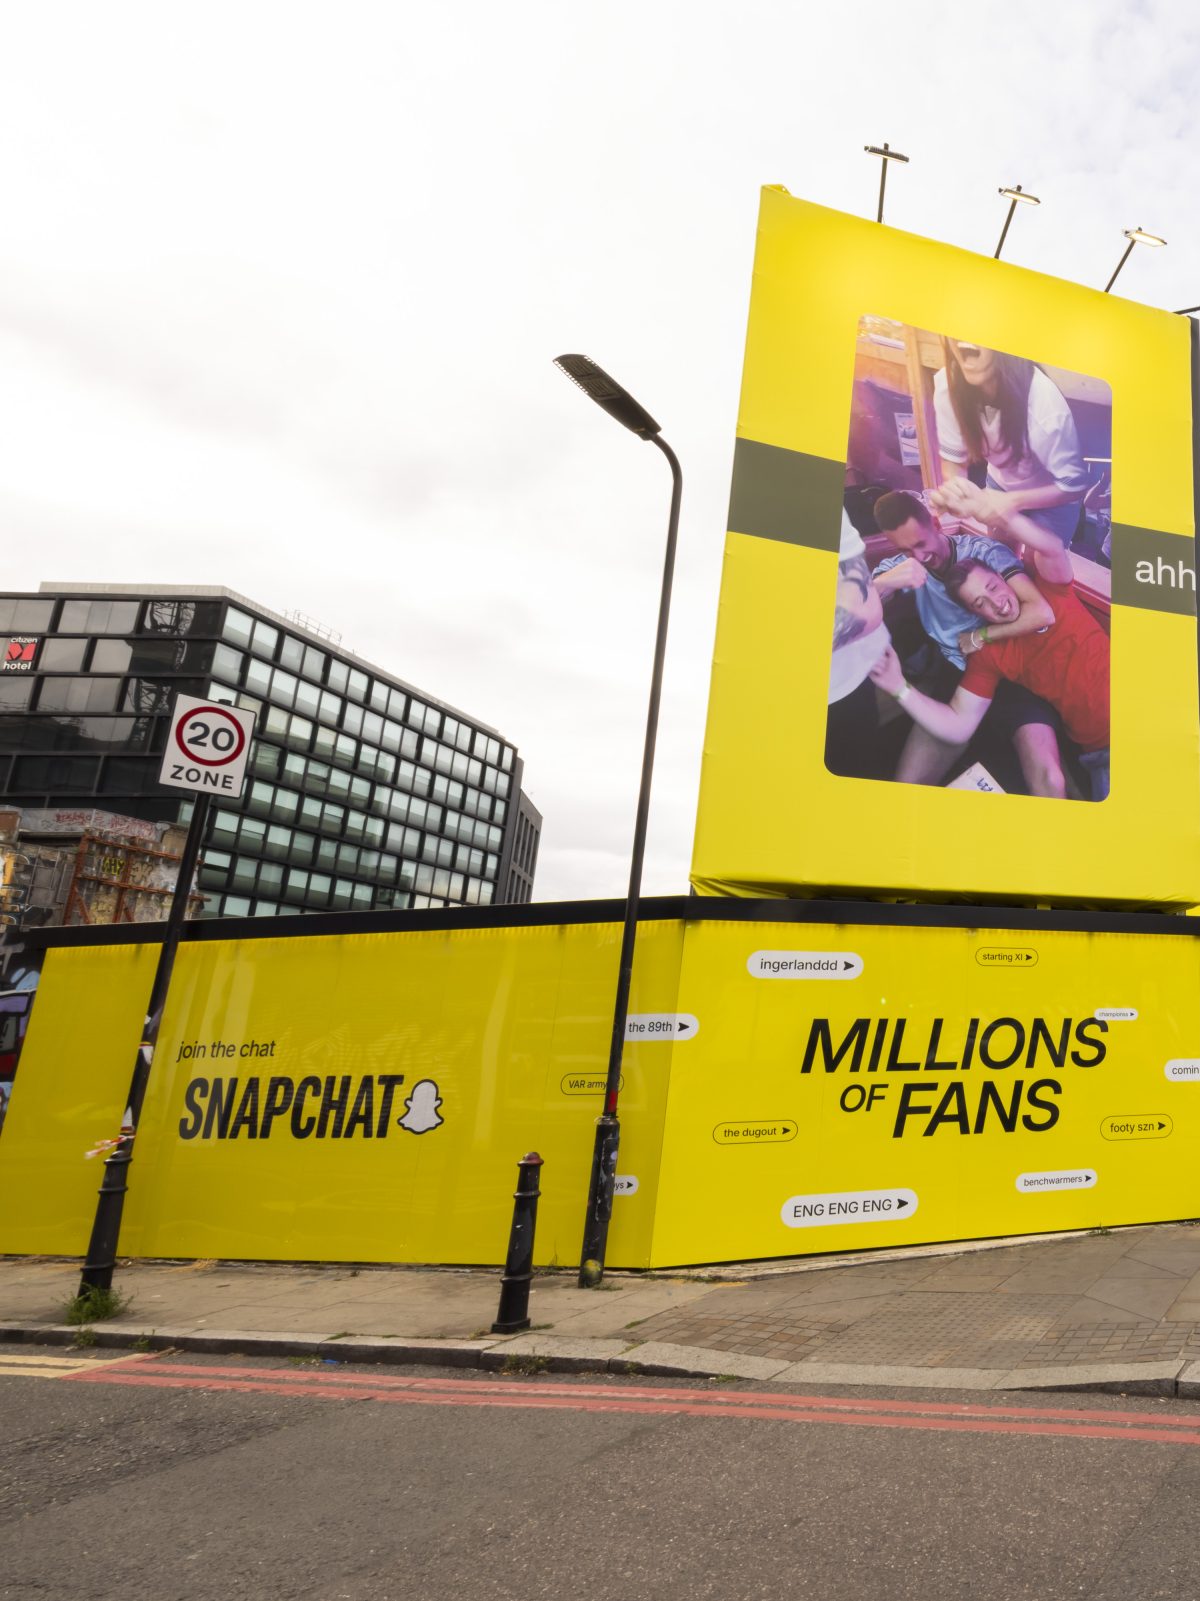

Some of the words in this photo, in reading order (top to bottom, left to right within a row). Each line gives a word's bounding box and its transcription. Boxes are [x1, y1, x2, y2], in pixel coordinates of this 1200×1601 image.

[1135, 556, 1197, 591] ahh
[3, 661, 32, 670] hotel
[187, 721, 235, 752] 20
[170, 764, 234, 790] ZONE
[760, 958, 838, 973] ingerlanddd
[982, 953, 1013, 962] starting
[628, 1022, 645, 1033] the
[647, 1021, 673, 1033] 89th
[176, 1041, 206, 1063] join
[211, 1041, 236, 1058] the
[239, 1040, 276, 1057] chat
[800, 1017, 1109, 1074] MILLIONS
[568, 1080, 586, 1089] VAR
[178, 1075, 404, 1140] SNAPCHAT
[839, 1084, 889, 1112] OF
[893, 1078, 1062, 1138] FANS
[723, 1127, 740, 1138] the
[742, 1126, 777, 1141] dugout
[1109, 1122, 1135, 1134] footy
[1137, 1122, 1155, 1132] szn
[1023, 1174, 1083, 1187] benchwarmers
[793, 1204, 825, 1219] ENG
[828, 1201, 859, 1216] ENG
[862, 1198, 892, 1213] ENG
